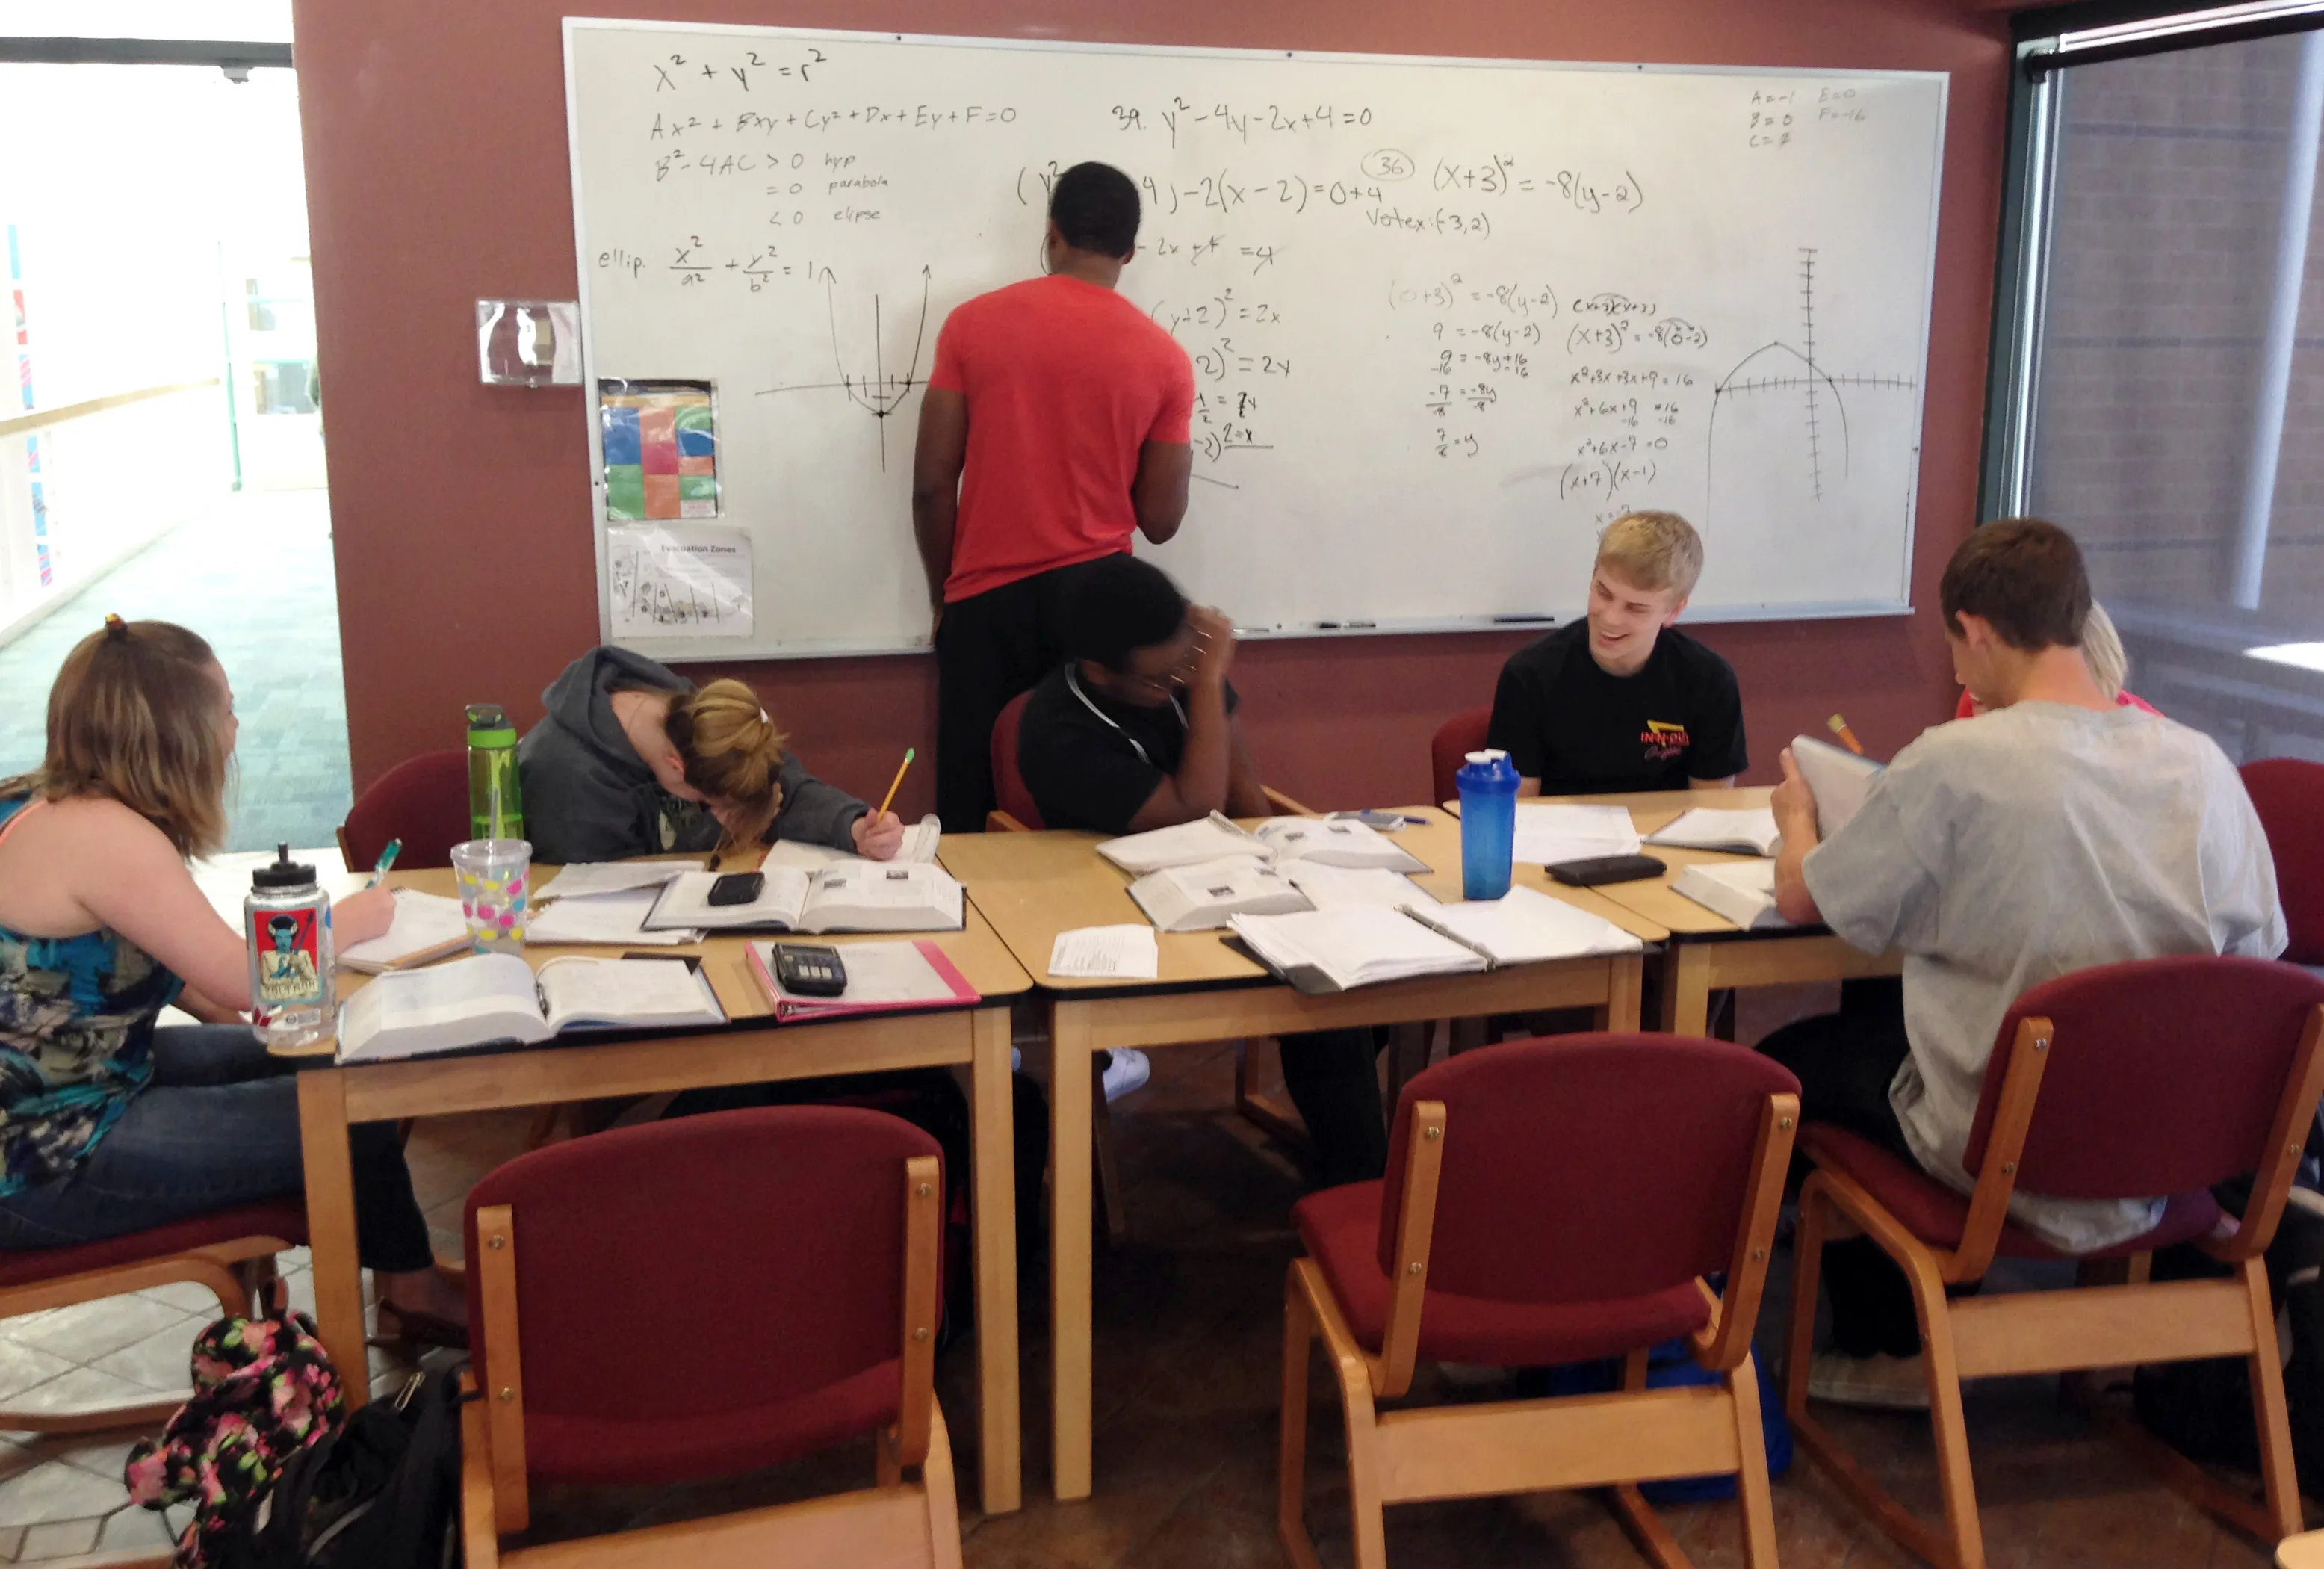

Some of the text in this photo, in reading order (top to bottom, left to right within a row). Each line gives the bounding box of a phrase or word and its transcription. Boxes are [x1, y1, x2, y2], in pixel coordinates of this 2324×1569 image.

[828, 175, 889, 194] parabola
[833, 206, 881, 223] elipse
[710, 545, 737, 553] Zones
